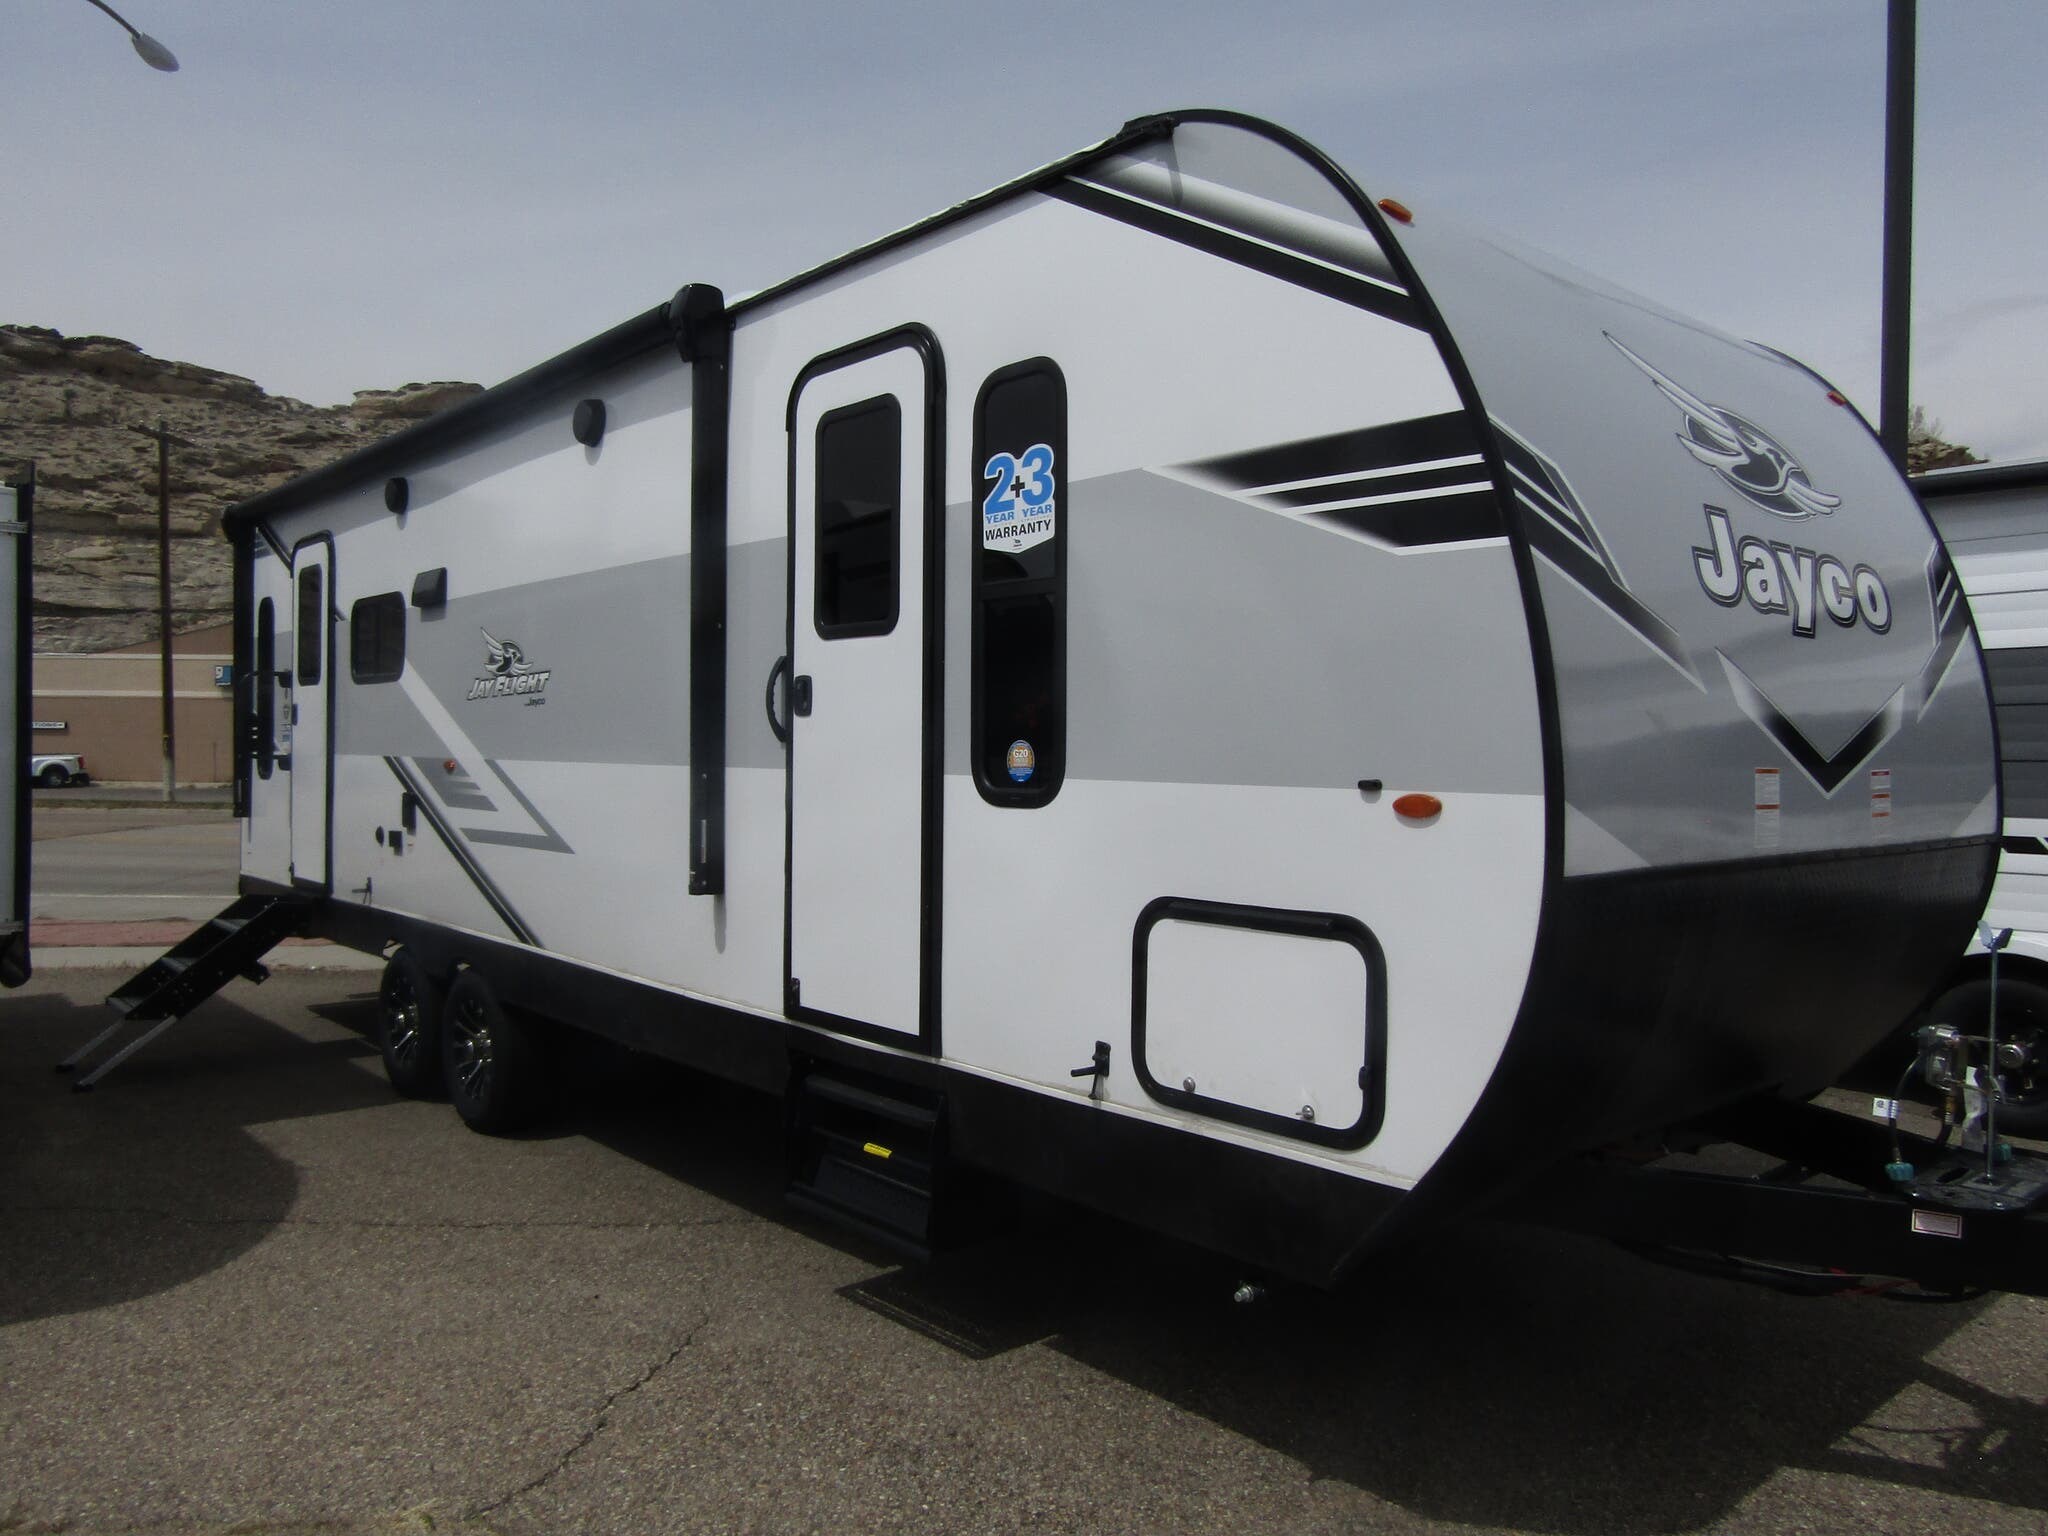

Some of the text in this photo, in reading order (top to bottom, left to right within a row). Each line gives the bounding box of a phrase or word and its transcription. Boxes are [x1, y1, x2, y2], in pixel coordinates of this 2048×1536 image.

[985, 511, 1015, 524] YEAR
[1022, 504, 1053, 517] YEAR
[985, 519, 1053, 541] WARRANTY
[1691, 504, 1892, 639] Jayco
[466, 670, 551, 701] JAY FLIGHT
